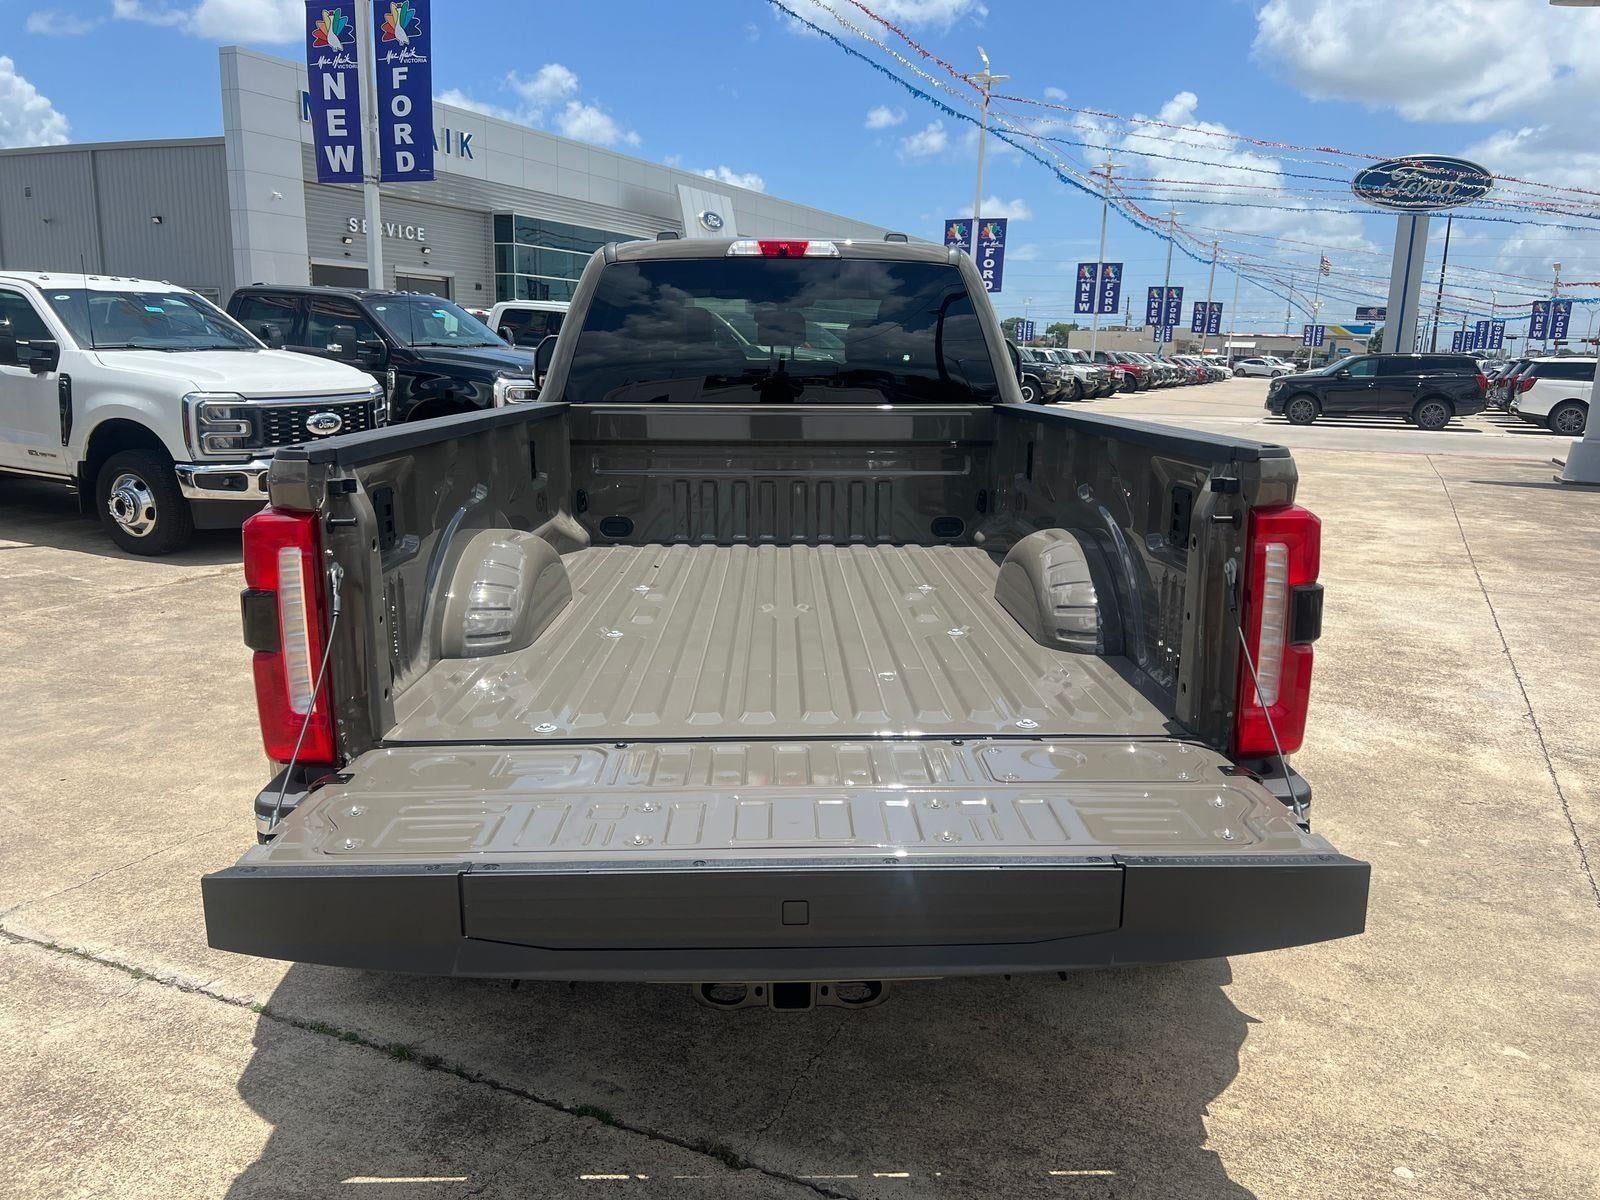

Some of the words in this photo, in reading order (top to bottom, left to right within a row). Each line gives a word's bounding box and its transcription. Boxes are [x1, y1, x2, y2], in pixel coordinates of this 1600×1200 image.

[322, 72, 355, 173] NEW
[391, 67, 415, 173] FORD
[1382, 166, 1462, 198] Ford
[982, 248, 995, 290] FORD
[1078, 283, 1090, 312] NEW
[1103, 283, 1114, 312] FORD
[1149, 302, 1159, 324] NEW
[1168, 302, 1177, 324] FORD
[1193, 314, 1203, 332] NEW
[1532, 315, 1544, 338] NEW
[1554, 315, 1564, 338] FORD
[319, 419, 336, 429] Ford
